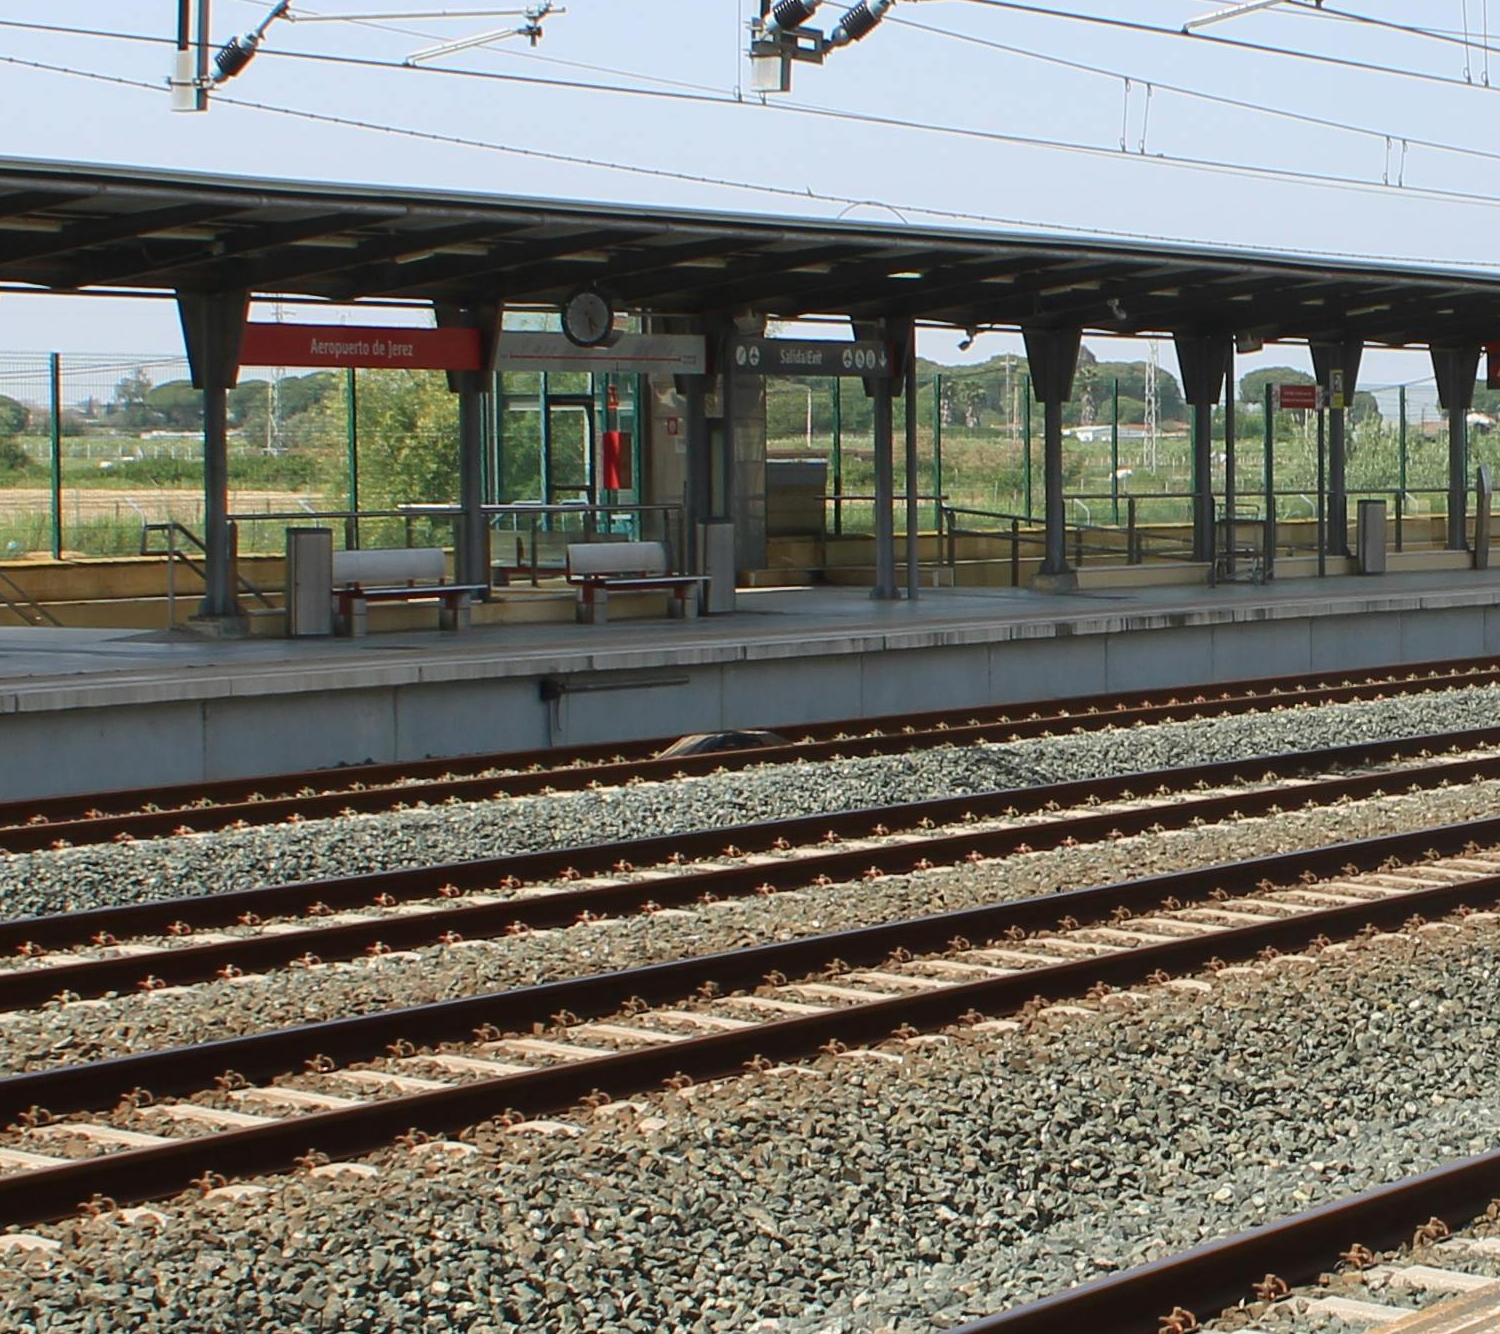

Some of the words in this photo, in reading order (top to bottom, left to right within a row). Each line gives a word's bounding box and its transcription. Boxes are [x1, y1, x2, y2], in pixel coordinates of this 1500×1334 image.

[310, 337, 370, 359] Aeropuerto
[371, 338, 386, 356] de
[387, 339, 413, 359] Jerez
